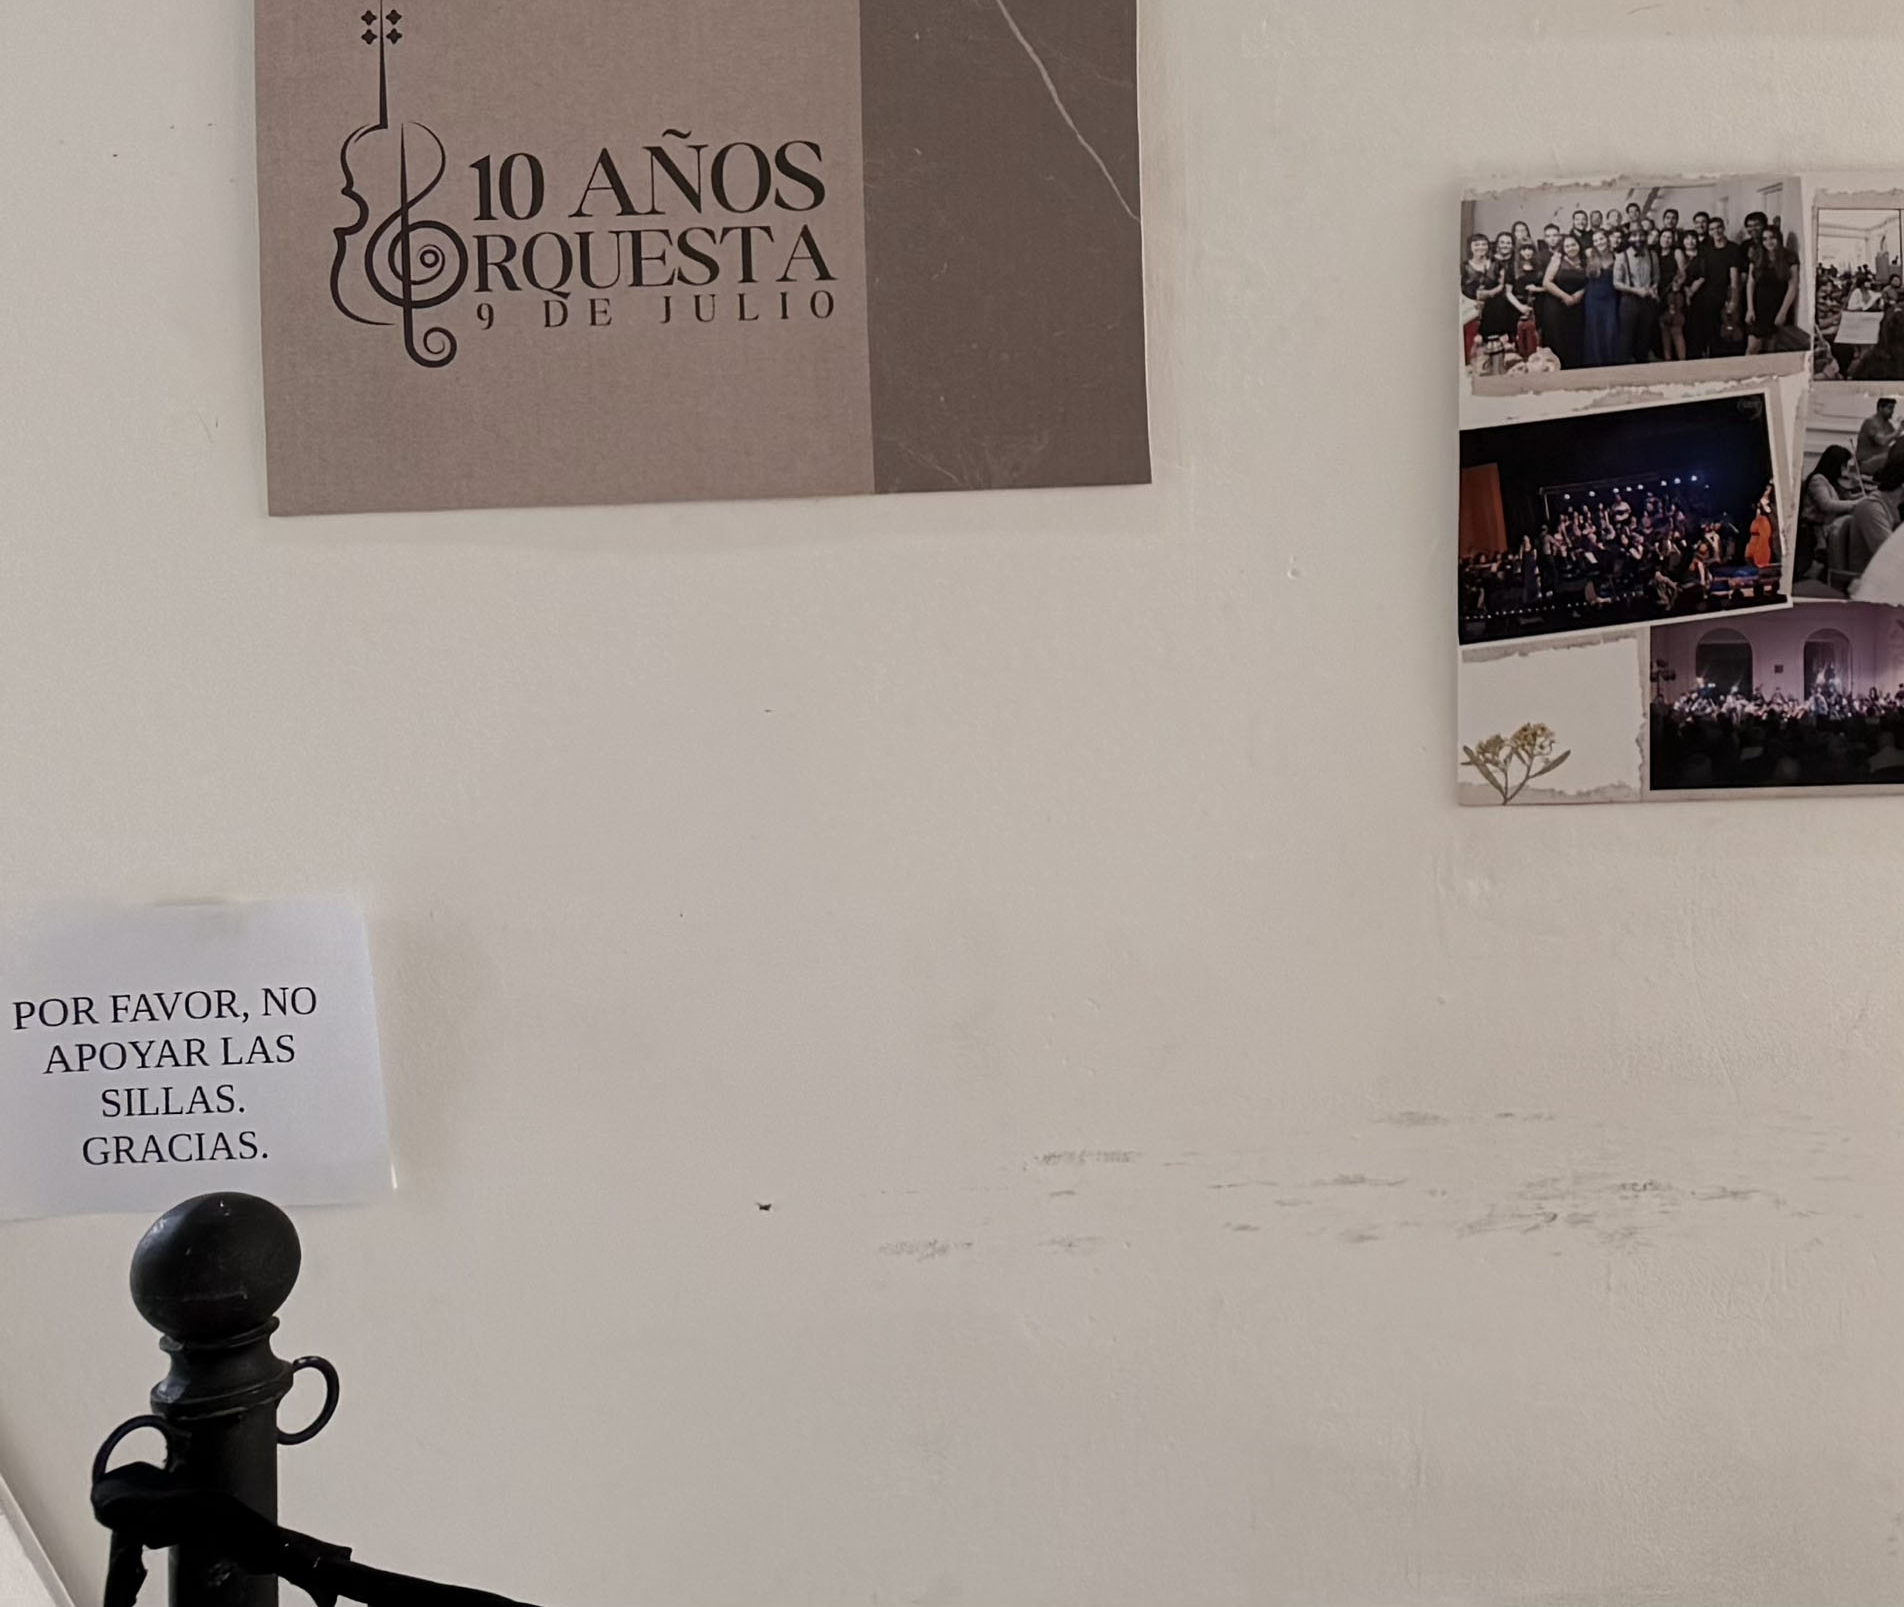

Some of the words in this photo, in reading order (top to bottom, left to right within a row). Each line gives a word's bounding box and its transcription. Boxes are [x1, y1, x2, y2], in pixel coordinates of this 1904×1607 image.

[469, 150, 546, 222] 10
[569, 127, 827, 217] AÑOS
[476, 301, 496, 331] 9
[542, 298, 613, 328] DE
[660, 290, 835, 326] JULIO
[12, 996, 100, 1030] POR
[109, 989, 250, 1023] FAVOR,
[262, 986, 317, 1016] NO
[42, 1038, 209, 1074] APOYAR
[222, 1034, 296, 1066] LAS
[102, 1083, 246, 1117] SILLAS.
[82, 1130, 269, 1166] GRACIAS.
